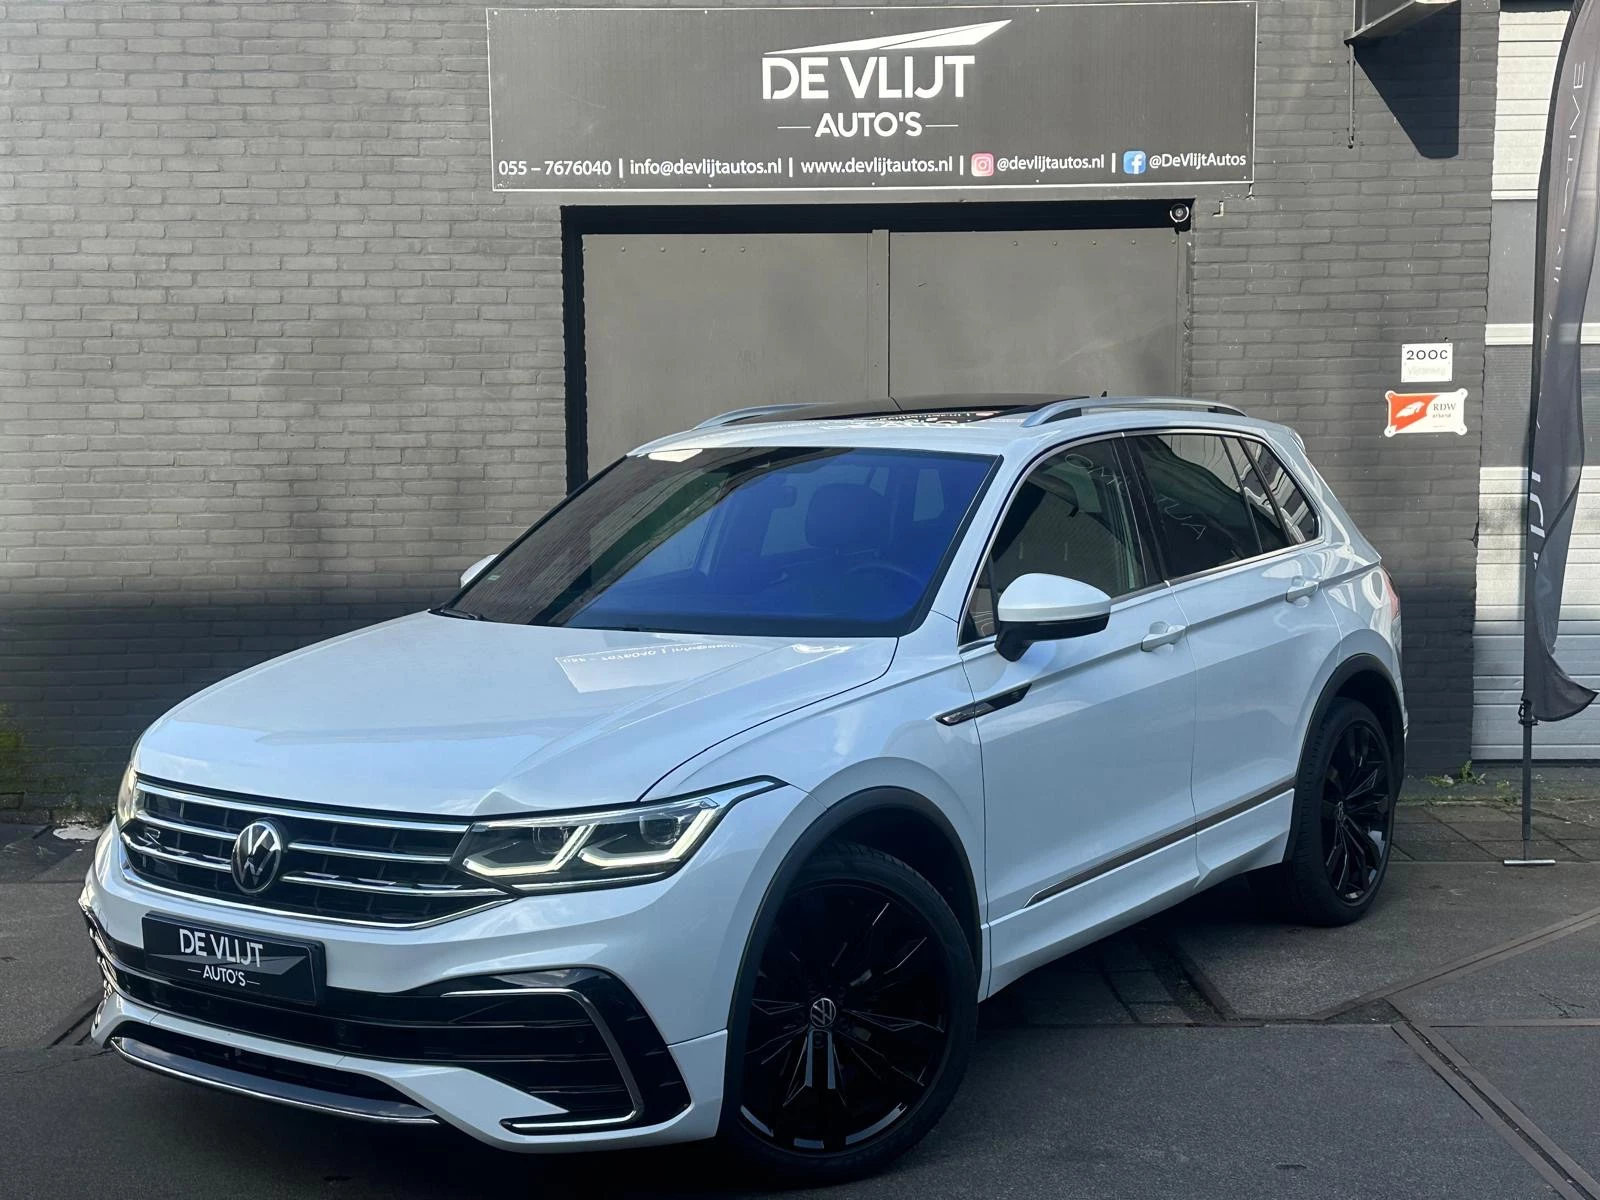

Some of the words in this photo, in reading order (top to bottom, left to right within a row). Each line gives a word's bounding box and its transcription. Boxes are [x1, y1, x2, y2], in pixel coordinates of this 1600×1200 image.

[762, 56, 829, 100] DE
[840, 55, 976, 99] VLIJT
[814, 111, 923, 138] AUTO'S
[498, 160, 528, 175] 055
[544, 160, 612, 175] 7676040
[629, 158, 783, 178] info@devlijtautos.nl
[800, 155, 953, 176] www.devlijtautos.nl
[996, 153, 1105, 173] @devlijtautos.nl
[1149, 152, 1247, 171] @DeVlijtAutos
[1433, 402, 1457, 412] RDW
[178, 928, 208, 957] DE
[209, 933, 264, 968] VLIJT
[202, 964, 247, 987] AUTO'S
